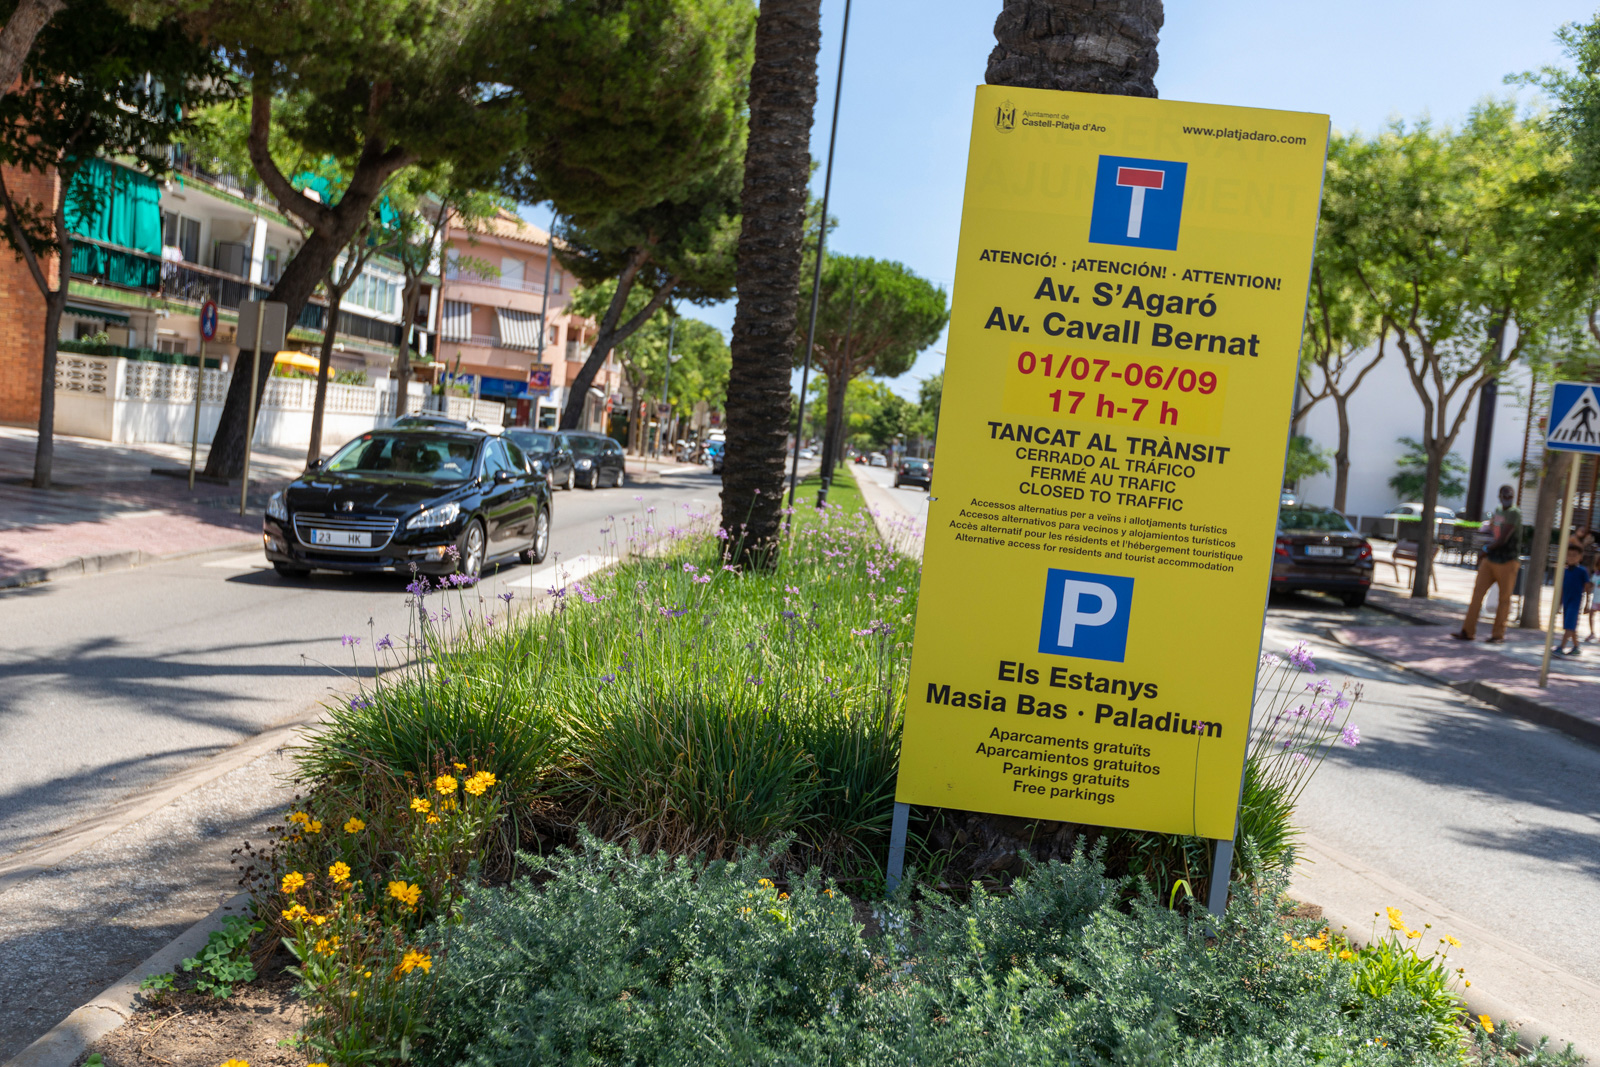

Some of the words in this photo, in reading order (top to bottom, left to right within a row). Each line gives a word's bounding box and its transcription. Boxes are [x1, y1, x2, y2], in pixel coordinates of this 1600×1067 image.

[1022, 110, 1060, 119] Ajuntament
[1022, 118, 1080, 131] Castell-Platja
[1082, 123, 1106, 132] d'Aro
[1182, 126, 1306, 145] www.platjadaro.com
[979, 249, 1057, 268] ATENCIÓ!
[1071, 258, 1167, 279] ¡ATENCIÓN!
[1181, 269, 1281, 291] ATTENTION!
[1033, 276, 1080, 303] Av.
[984, 306, 1030, 333] Av.
[1043, 312, 1140, 344] Cavall
[1151, 322, 1260, 357] Bernat
[1017, 351, 1217, 395] 01/07-06/09
[1049, 389, 1086, 414] 17
[1096, 393, 1149, 422] h-7
[1159, 400, 1178, 426] h
[987, 421, 1081, 448] TANCAT
[1086, 433, 1117, 453] AL
[1126, 436, 1231, 464] TRÀNSIT
[1015, 447, 1095, 467] CERRADO
[1099, 456, 1120, 470] AL
[1125, 458, 1196, 478] TRÁFICO
[1030, 466, 1087, 484] FERMÉ
[1090, 472, 1114, 487] AU
[1118, 475, 1176, 493] TRAFIC
[1019, 481, 1085, 500] CLOSED
[1090, 489, 1111, 503] TO
[1116, 492, 1183, 512] TRAFFIC
[959, 509, 999, 520] Accesos
[1001, 514, 1056, 527] alternativos
[1058, 522, 1080, 530] para
[1082, 525, 1119, 535] vecinos
[1121, 529, 1127, 537] y
[1129, 529, 1189, 542] alojamientos
[1192, 536, 1236, 548] turísticos
[970, 498, 1016, 511] Accessos
[1018, 504, 1068, 516] alternatius
[1097, 513, 1121, 523] veïns
[1129, 516, 1187, 530] allotjaments
[1189, 523, 1227, 534] turístics
[949, 520, 978, 530] Accès
[980, 524, 1022, 535] alternatif
[1024, 530, 1046, 538] pour
[1048, 531, 1062, 540] les
[1064, 534, 1108, 546] résidents
[1122, 540, 1190, 555] l'hébergement
[1192, 548, 1243, 561] touristique
[955, 533, 1005, 546] Alternative
[1007, 540, 1041, 550] access
[1043, 543, 1056, 551] for
[1058, 546, 1102, 557] residents
[1104, 552, 1122, 560] and
[1125, 553, 1155, 563] tourist
[1157, 558, 1234, 572] accommodation
[1057, 579, 1117, 648] P
[998, 660, 1040, 685] Els
[1049, 666, 1158, 701] Estanys
[926, 682, 1006, 712] Masia
[1016, 694, 1067, 720] Bas
[1094, 703, 1223, 738] Paladium
[975, 742, 1089, 767] Aparcamientos
[1093, 759, 1160, 775] gratuitos
[989, 727, 1089, 750] Aparcaments
[1093, 742, 1151, 757] gratuïts
[1003, 762, 1068, 783] Parkings
[1072, 773, 1130, 788] gratuits
[1013, 780, 1046, 795] Free
[1050, 787, 1115, 805] parkings
